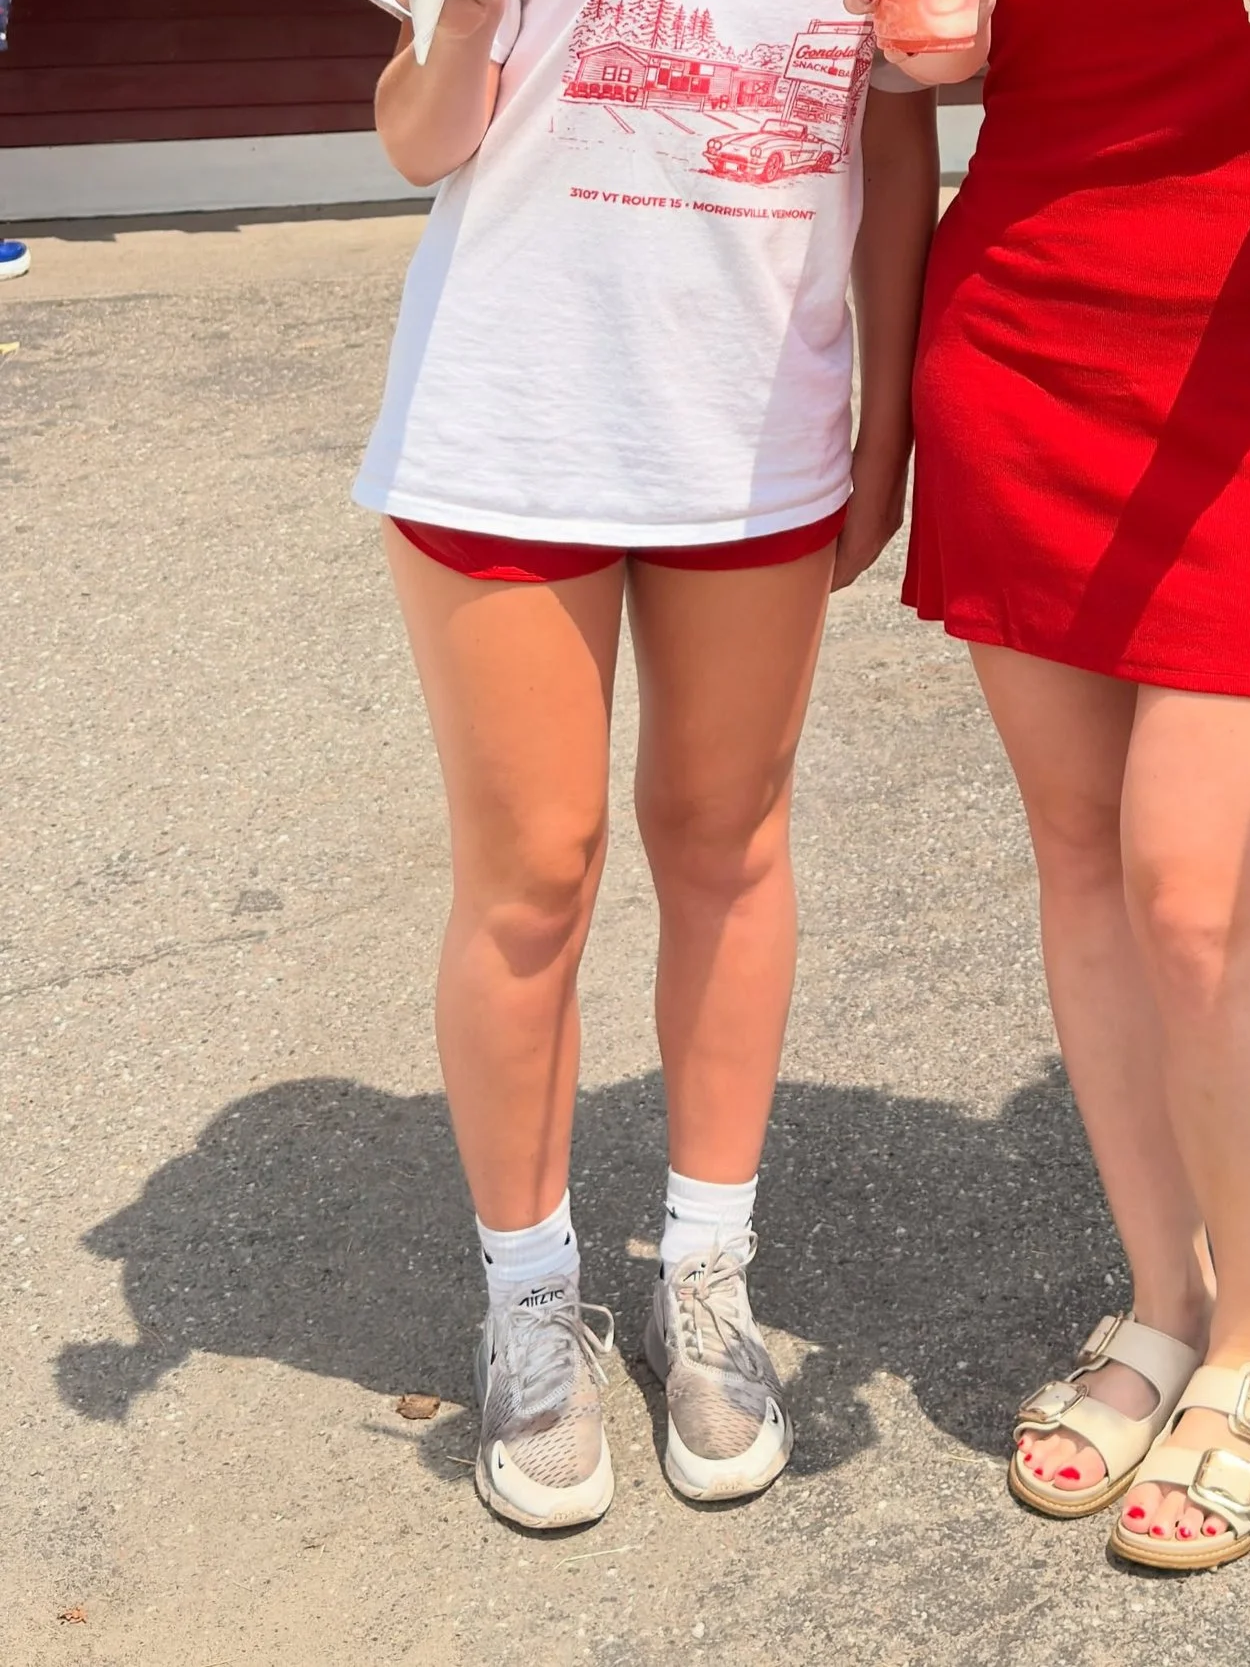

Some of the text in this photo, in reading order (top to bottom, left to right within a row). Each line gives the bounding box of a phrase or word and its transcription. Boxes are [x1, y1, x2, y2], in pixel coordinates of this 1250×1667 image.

[796, 44, 856, 59] Gondola
[792, 60, 828, 73] SNACK
[570, 187, 599, 200] 3107
[602, 192, 619, 203] VT
[622, 194, 666, 208] ROUTE
[669, 198, 682, 208] 15
